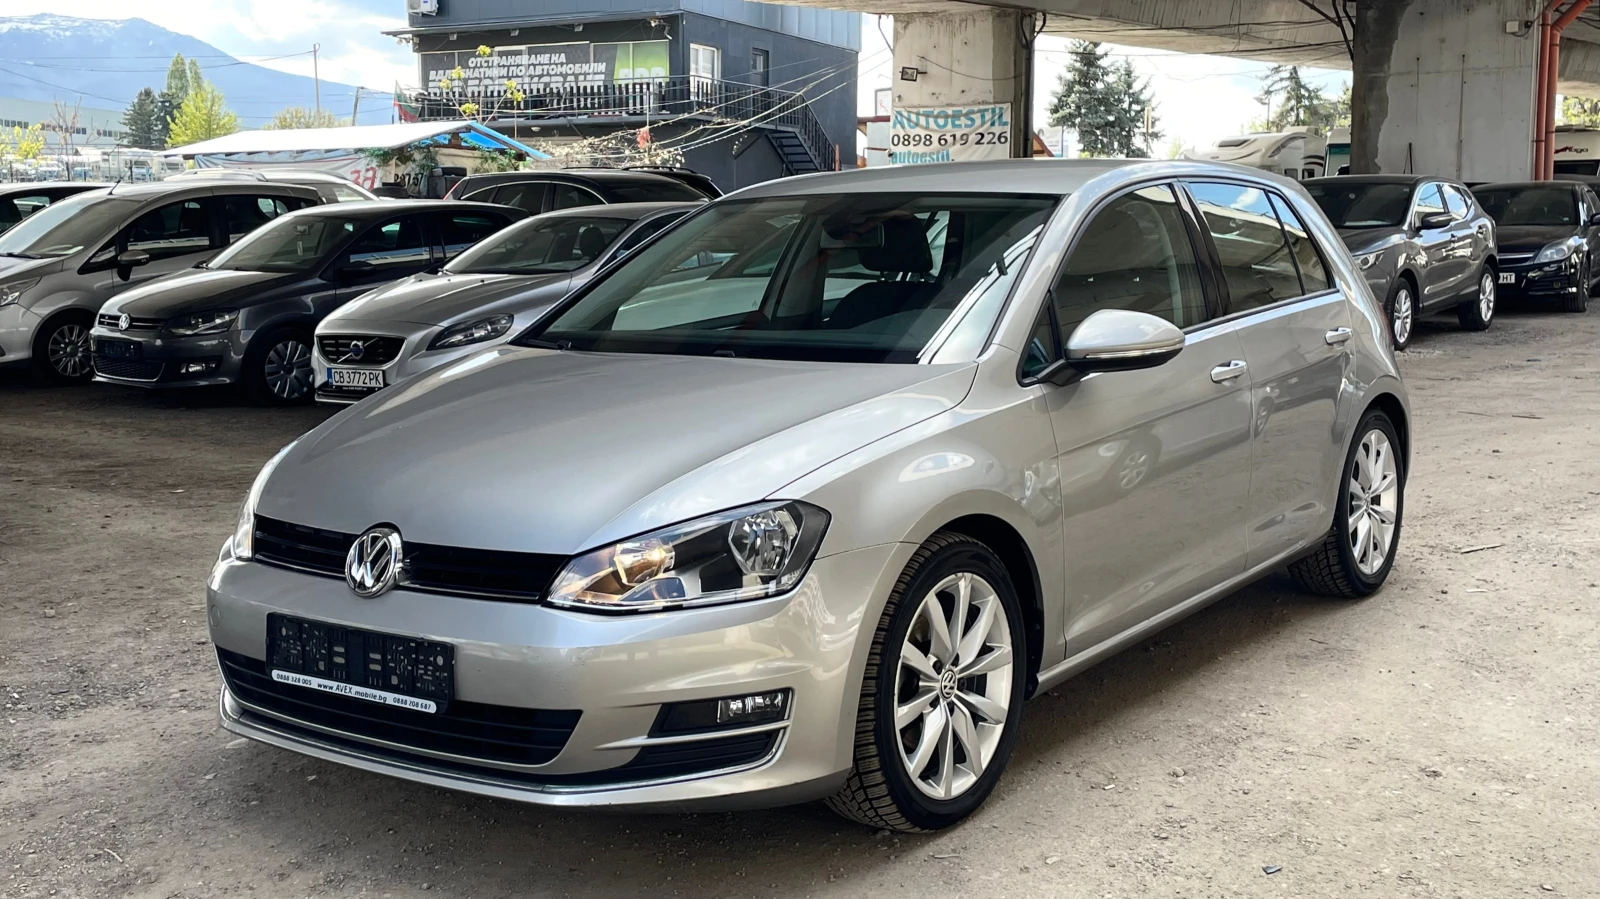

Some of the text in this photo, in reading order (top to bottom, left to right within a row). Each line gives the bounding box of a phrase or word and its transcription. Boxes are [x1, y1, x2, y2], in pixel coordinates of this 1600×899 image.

[468, 53, 566, 67] ОТСТРАНЯВАНЕ НА
[509, 66, 525, 77] ПО
[527, 63, 606, 75] АВТОМОБИЛИ
[892, 107, 1009, 129] AUTOESTIL
[891, 131, 1009, 147] 0898 619 226
[891, 149, 950, 165] autoestil
